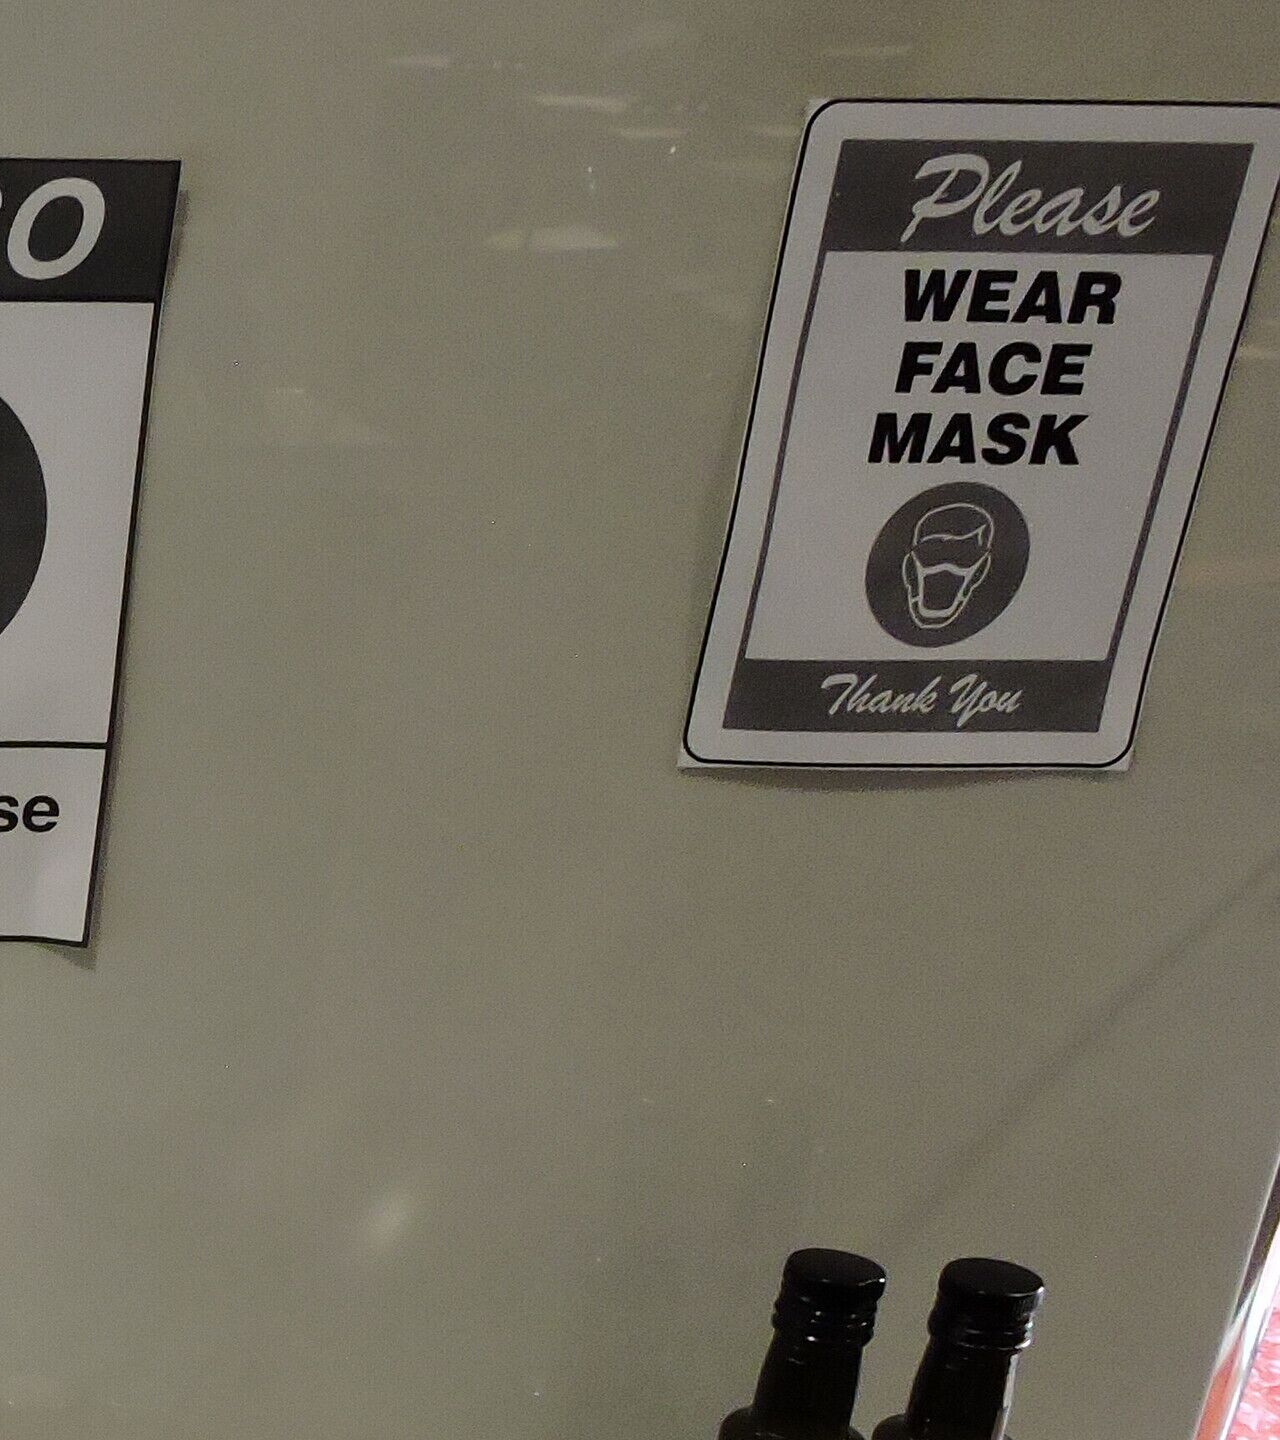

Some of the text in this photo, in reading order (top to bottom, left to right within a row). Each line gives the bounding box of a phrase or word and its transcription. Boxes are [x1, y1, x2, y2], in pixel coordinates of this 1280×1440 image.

[900, 153, 1159, 243] Please
[903, 269, 1123, 325] WEAR
[894, 342, 1093, 396] FACE
[867, 412, 1089, 465] MASK
[820, 672, 1023, 728] Thank You
